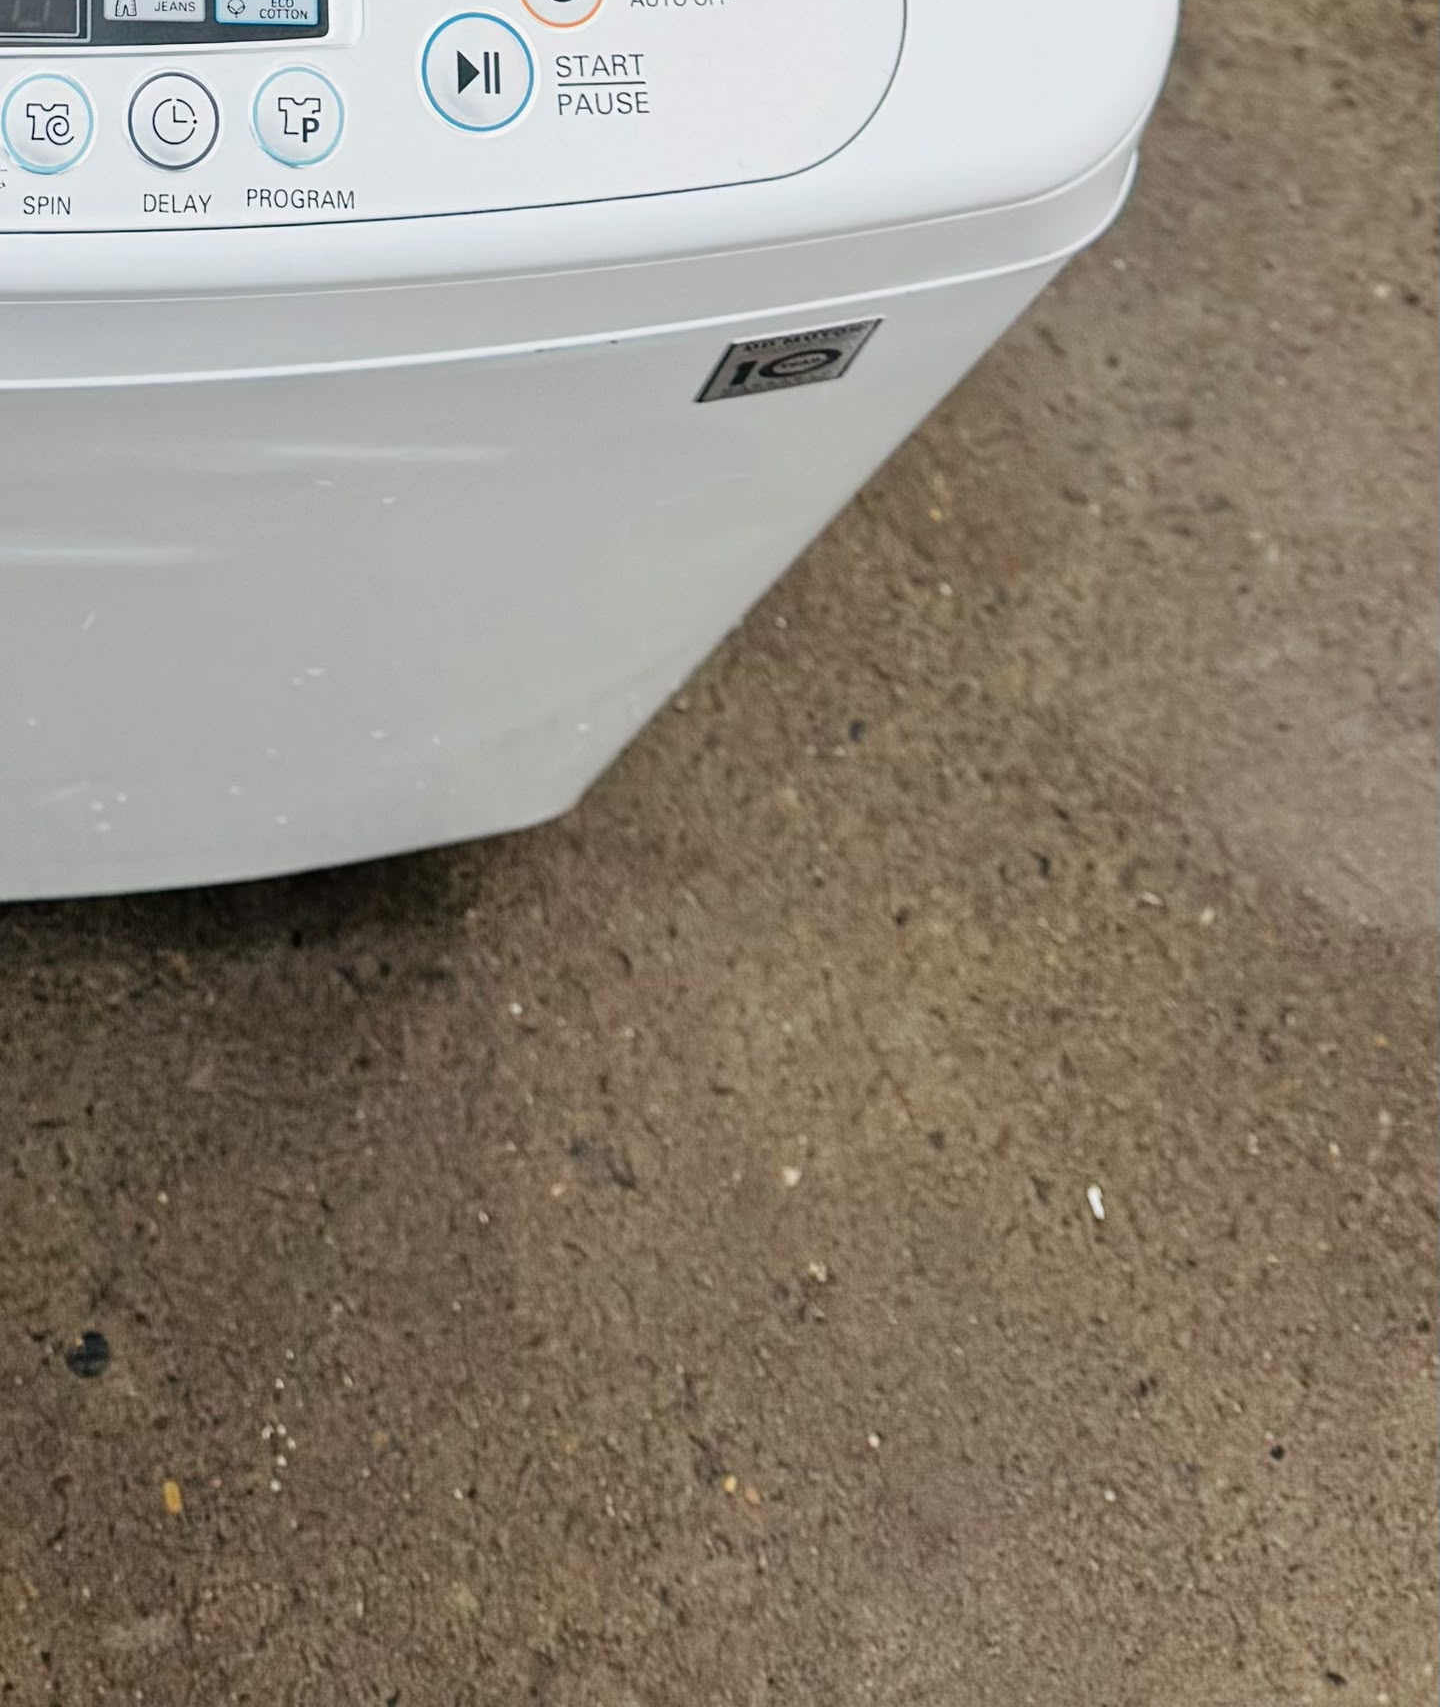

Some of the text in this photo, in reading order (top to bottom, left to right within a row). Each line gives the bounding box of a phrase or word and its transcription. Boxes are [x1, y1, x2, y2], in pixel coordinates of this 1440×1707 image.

[154, 1, 196, 13] JEANS
[259, 9, 308, 20] COTTON
[556, 54, 644, 78] START
[558, 92, 650, 115] PAUSE
[23, 195, 72, 215] SPIN
[143, 193, 212, 213] DELAY
[246, 189, 355, 209] PROGRAM
